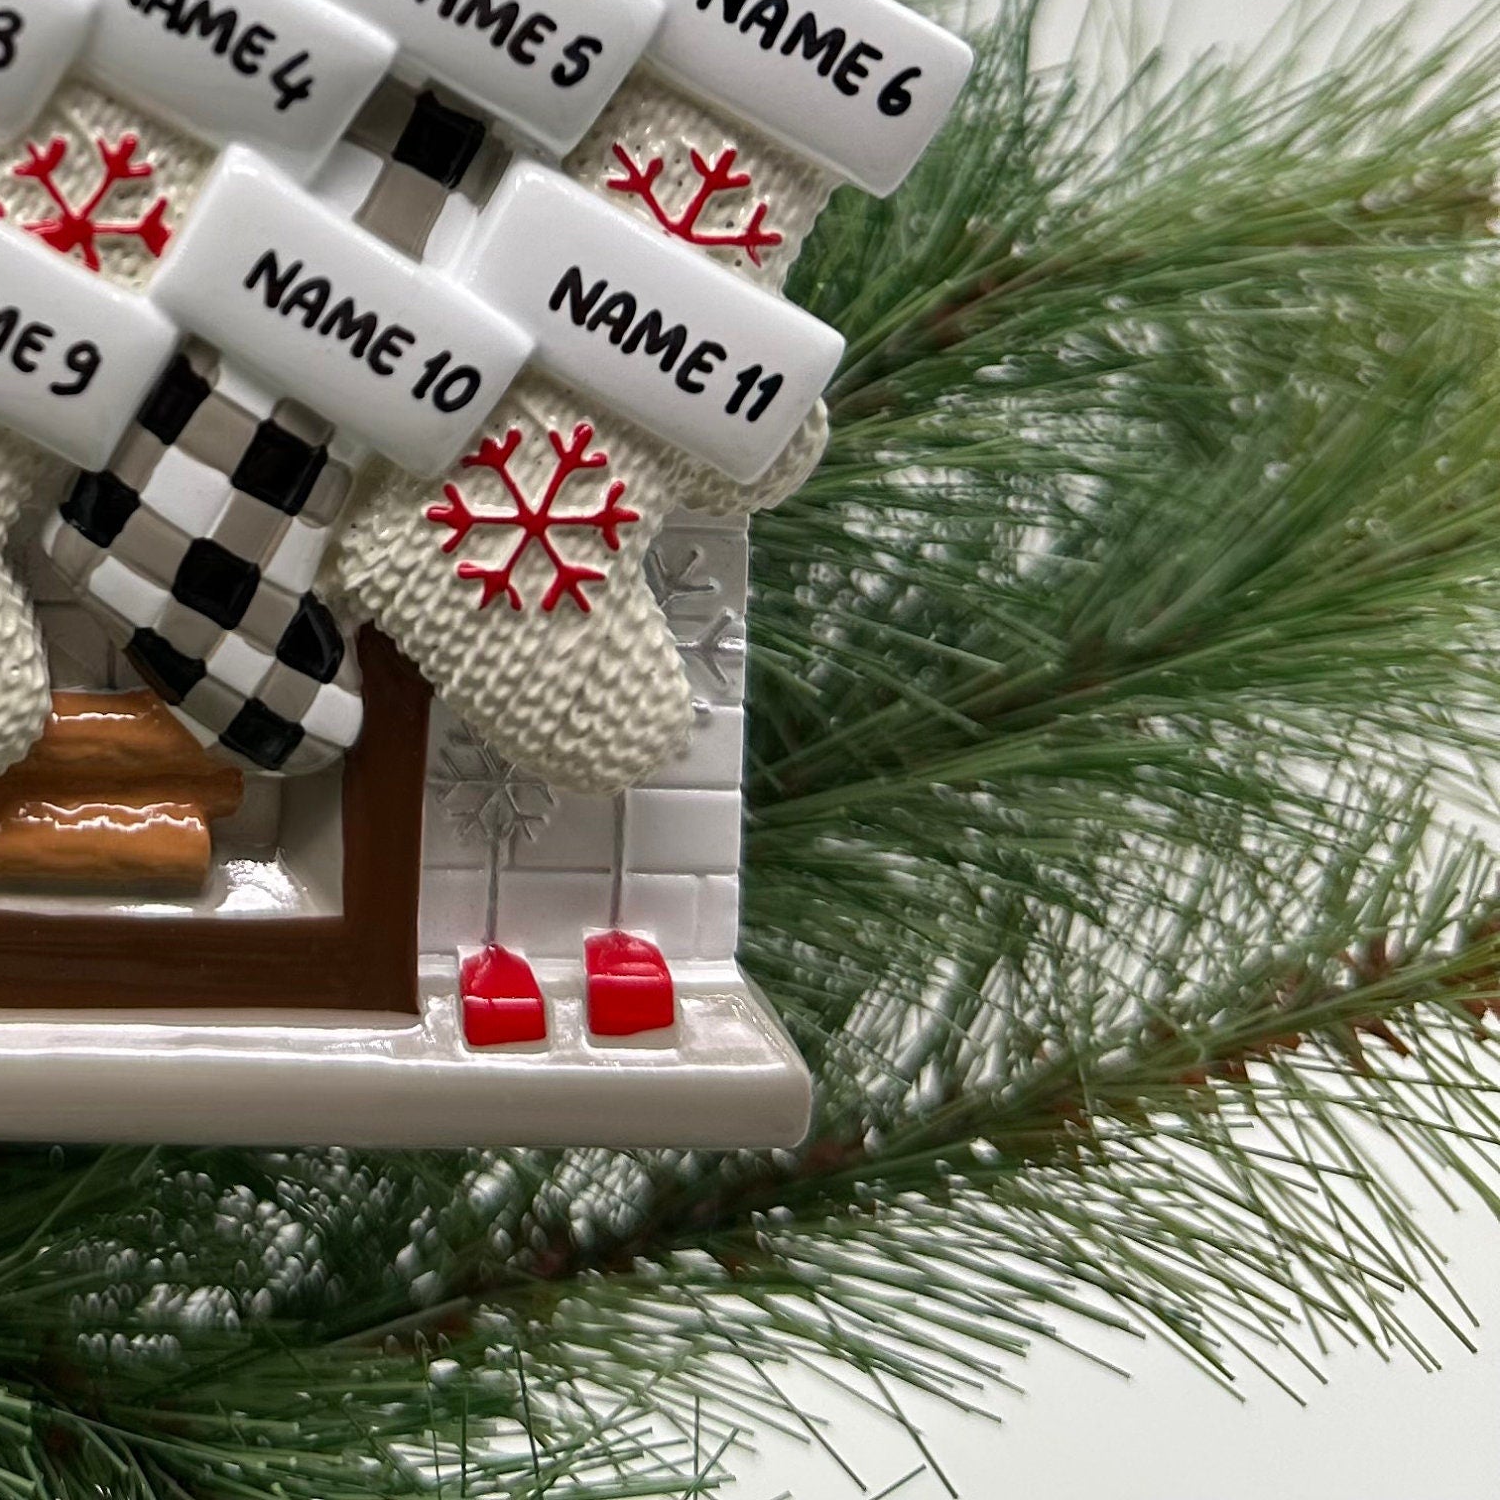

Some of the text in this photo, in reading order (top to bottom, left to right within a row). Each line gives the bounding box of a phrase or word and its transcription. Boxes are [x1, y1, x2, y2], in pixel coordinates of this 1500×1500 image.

[268, 50, 315, 113] 4
[549, 34, 604, 90] 5
[876, 65, 923, 118] 6
[243, 250, 483, 415] NAME 10
[547, 265, 785, 424] NAME 11
[48, 340, 103, 398] 9
